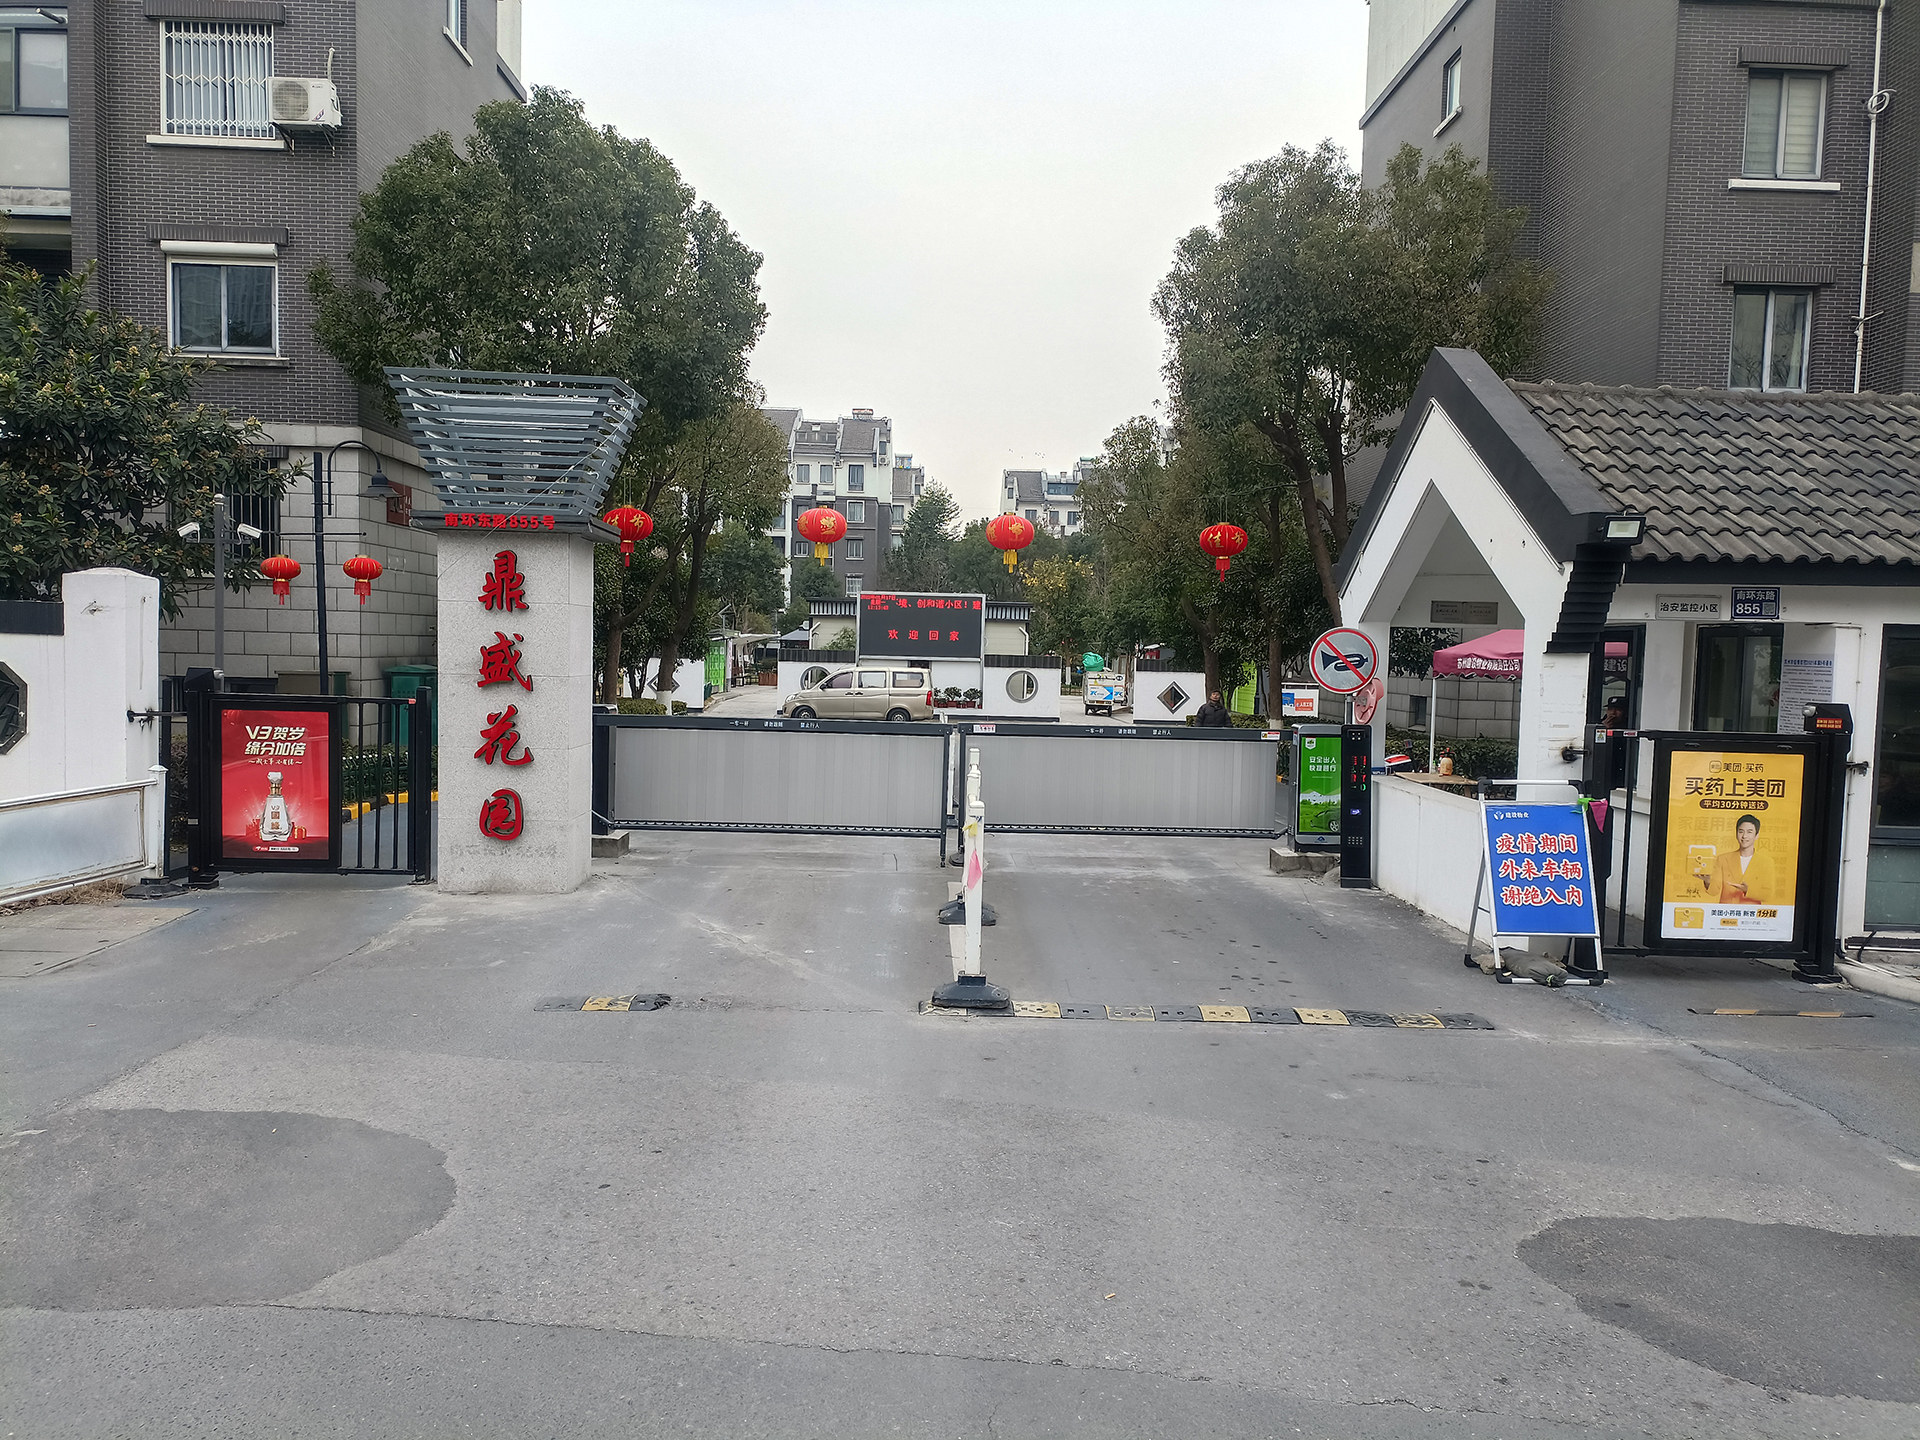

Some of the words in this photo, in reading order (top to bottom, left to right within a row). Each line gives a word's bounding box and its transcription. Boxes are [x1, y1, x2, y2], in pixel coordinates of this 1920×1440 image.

[444, 512, 556, 530] 南环东路855号
[1736, 590, 1776, 601] 南环东路
[1659, 602, 1719, 613] 治安监控小区
[1735, 603, 1760, 615] 855
[887, 629, 960, 642] 欢迎回家
[474, 550, 534, 841] 鼎盛花园
[245, 725, 306, 741] V3贺岁
[244, 741, 307, 756] 缘分加倍
[1685, 777, 1786, 798] 买药上美团
[1703, 800, 1766, 811] 平均30分钟送达
[1496, 832, 1579, 855] 疫情期间
[1498, 857, 1583, 881] 外来车辆
[1500, 885, 1584, 907] 谢绝入内
